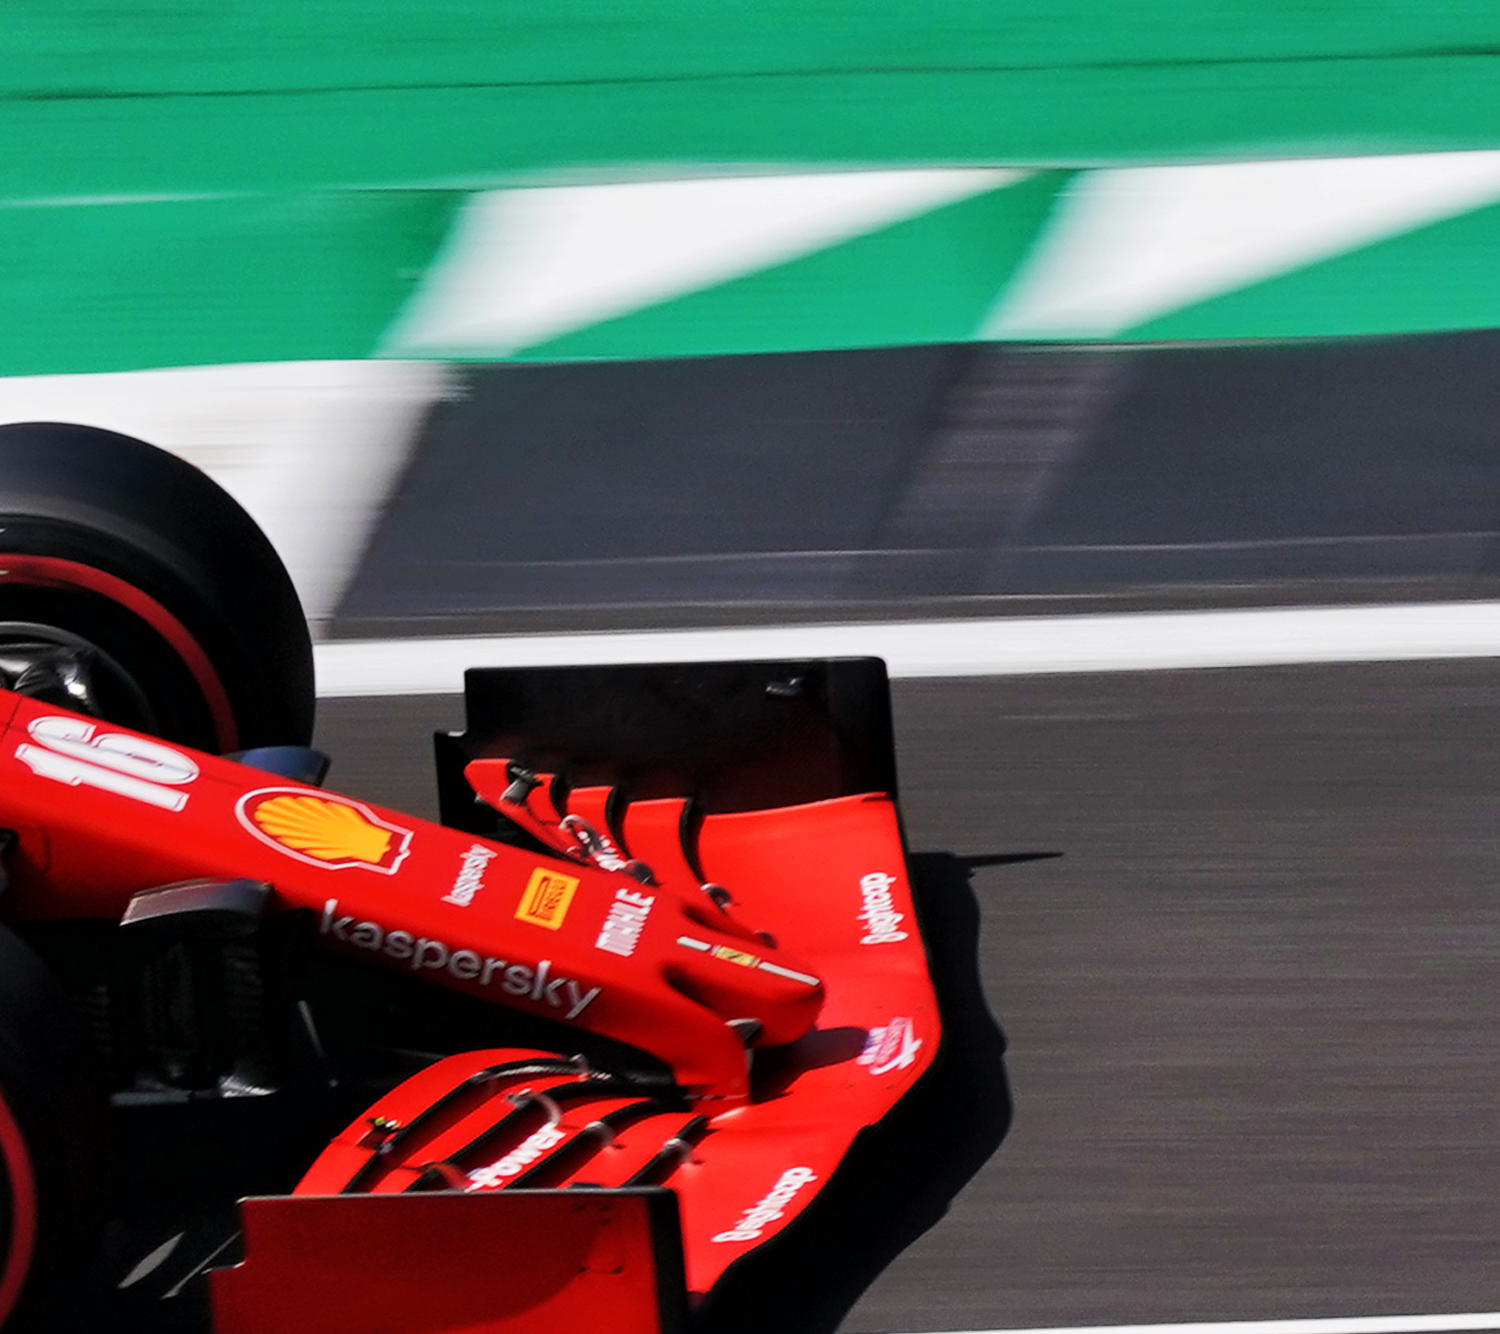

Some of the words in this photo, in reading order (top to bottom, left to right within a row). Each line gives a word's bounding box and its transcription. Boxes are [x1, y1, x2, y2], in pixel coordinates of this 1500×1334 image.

[14, 716, 199, 812] 16
[319, 898, 604, 1018] kaspersky
[595, 888, 655, 957] MAHLE
